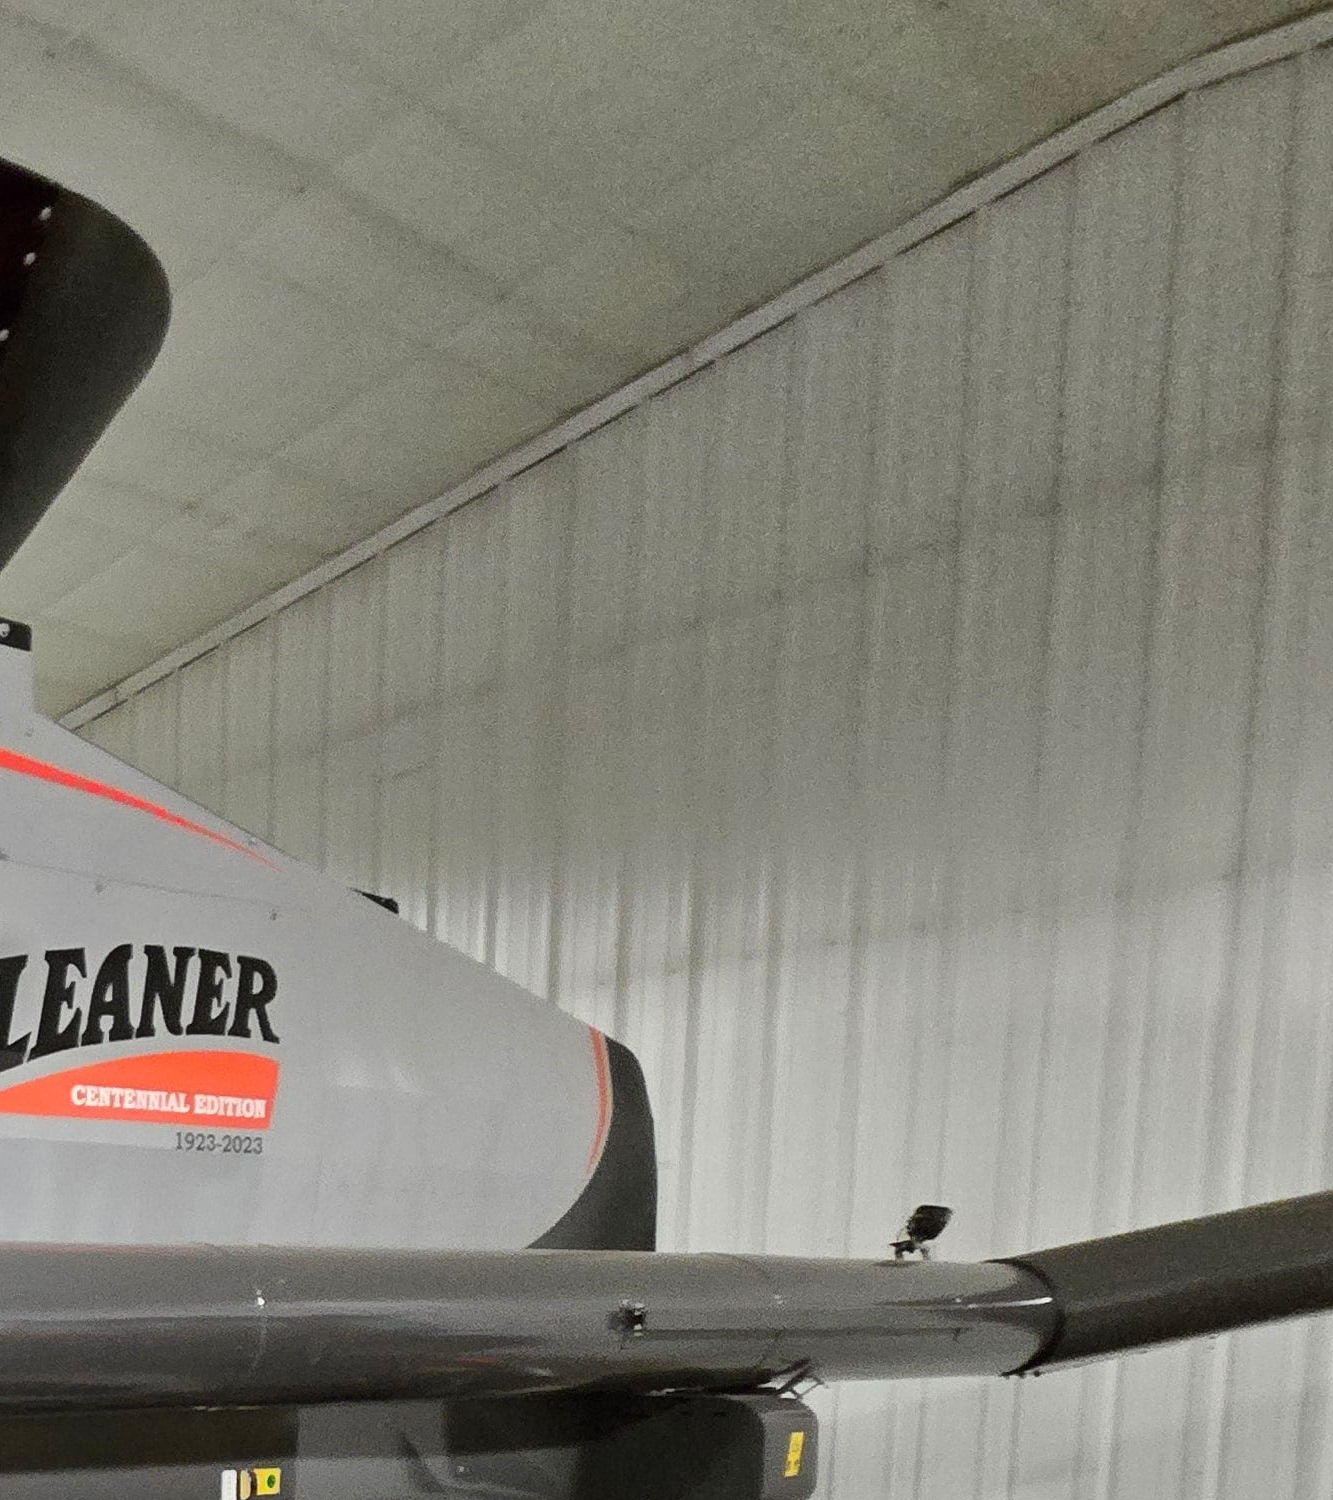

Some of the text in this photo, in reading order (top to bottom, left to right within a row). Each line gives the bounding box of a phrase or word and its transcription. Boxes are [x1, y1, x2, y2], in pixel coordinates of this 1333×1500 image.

[70, 1084, 267, 1119] CENTENNIAL EDITION
[174, 1131, 264, 1156] 1923-2023
